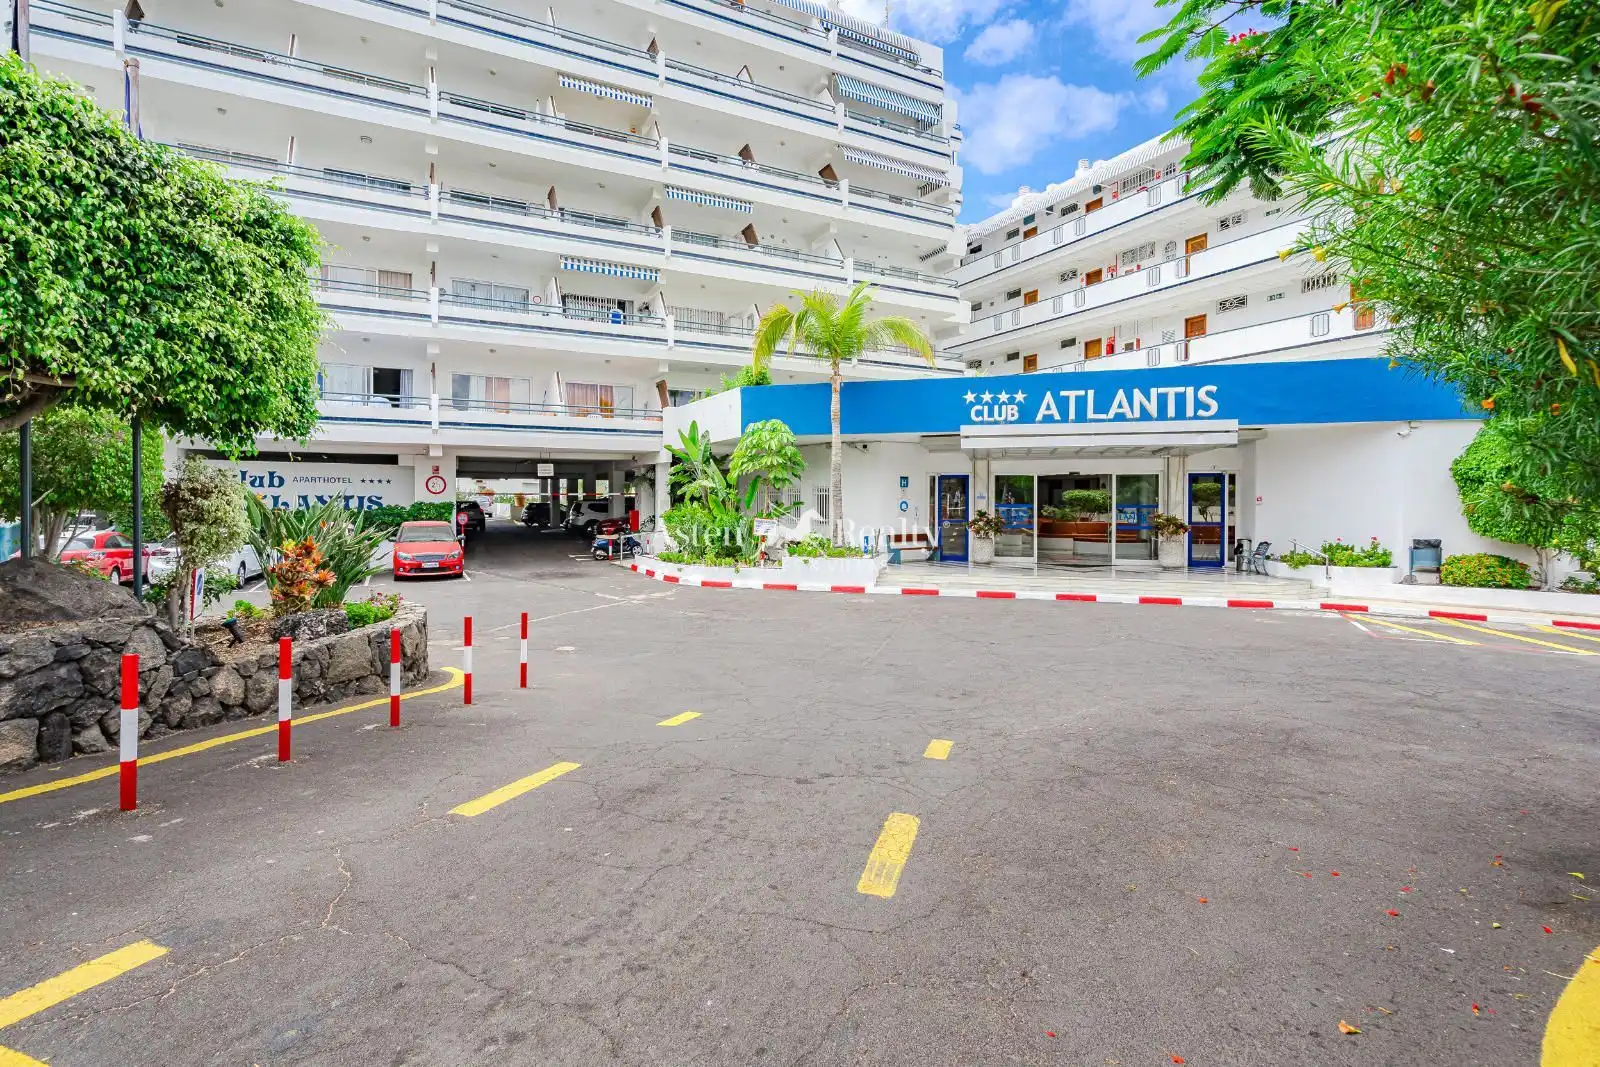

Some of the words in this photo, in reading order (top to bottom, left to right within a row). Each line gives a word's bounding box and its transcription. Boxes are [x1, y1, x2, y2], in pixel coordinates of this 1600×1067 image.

[1035, 385, 1219, 421] ATLANTIS
[970, 404, 1019, 422] CLUB
[292, 476, 353, 484] APARTHOTEL
